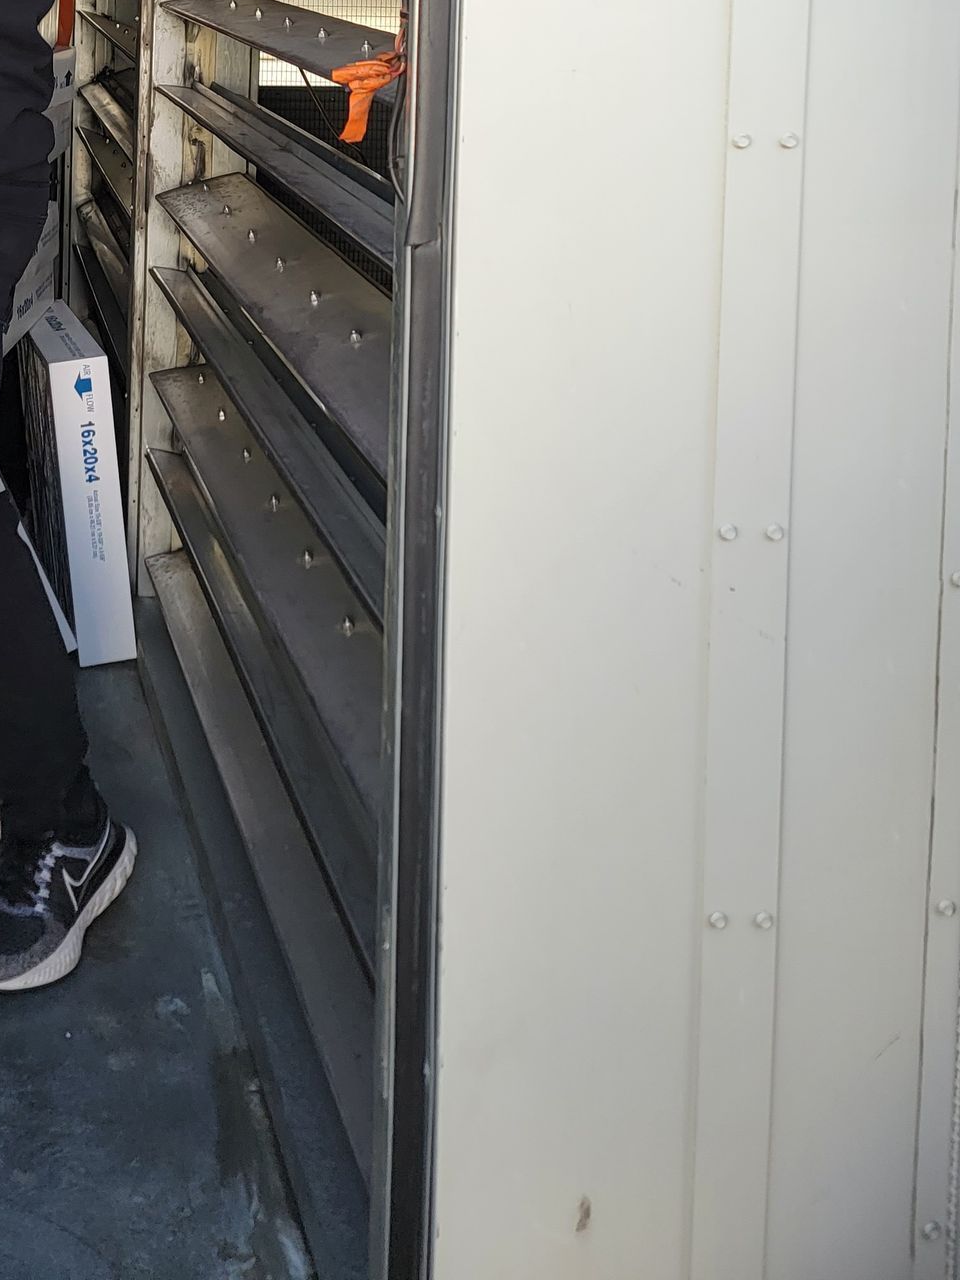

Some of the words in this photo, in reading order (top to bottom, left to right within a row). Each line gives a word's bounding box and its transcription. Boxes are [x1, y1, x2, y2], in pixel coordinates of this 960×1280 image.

[82, 364, 92, 376] AIR
[85, 393, 95, 412] FLOW
[80, 421, 100, 484] 16x20x4
